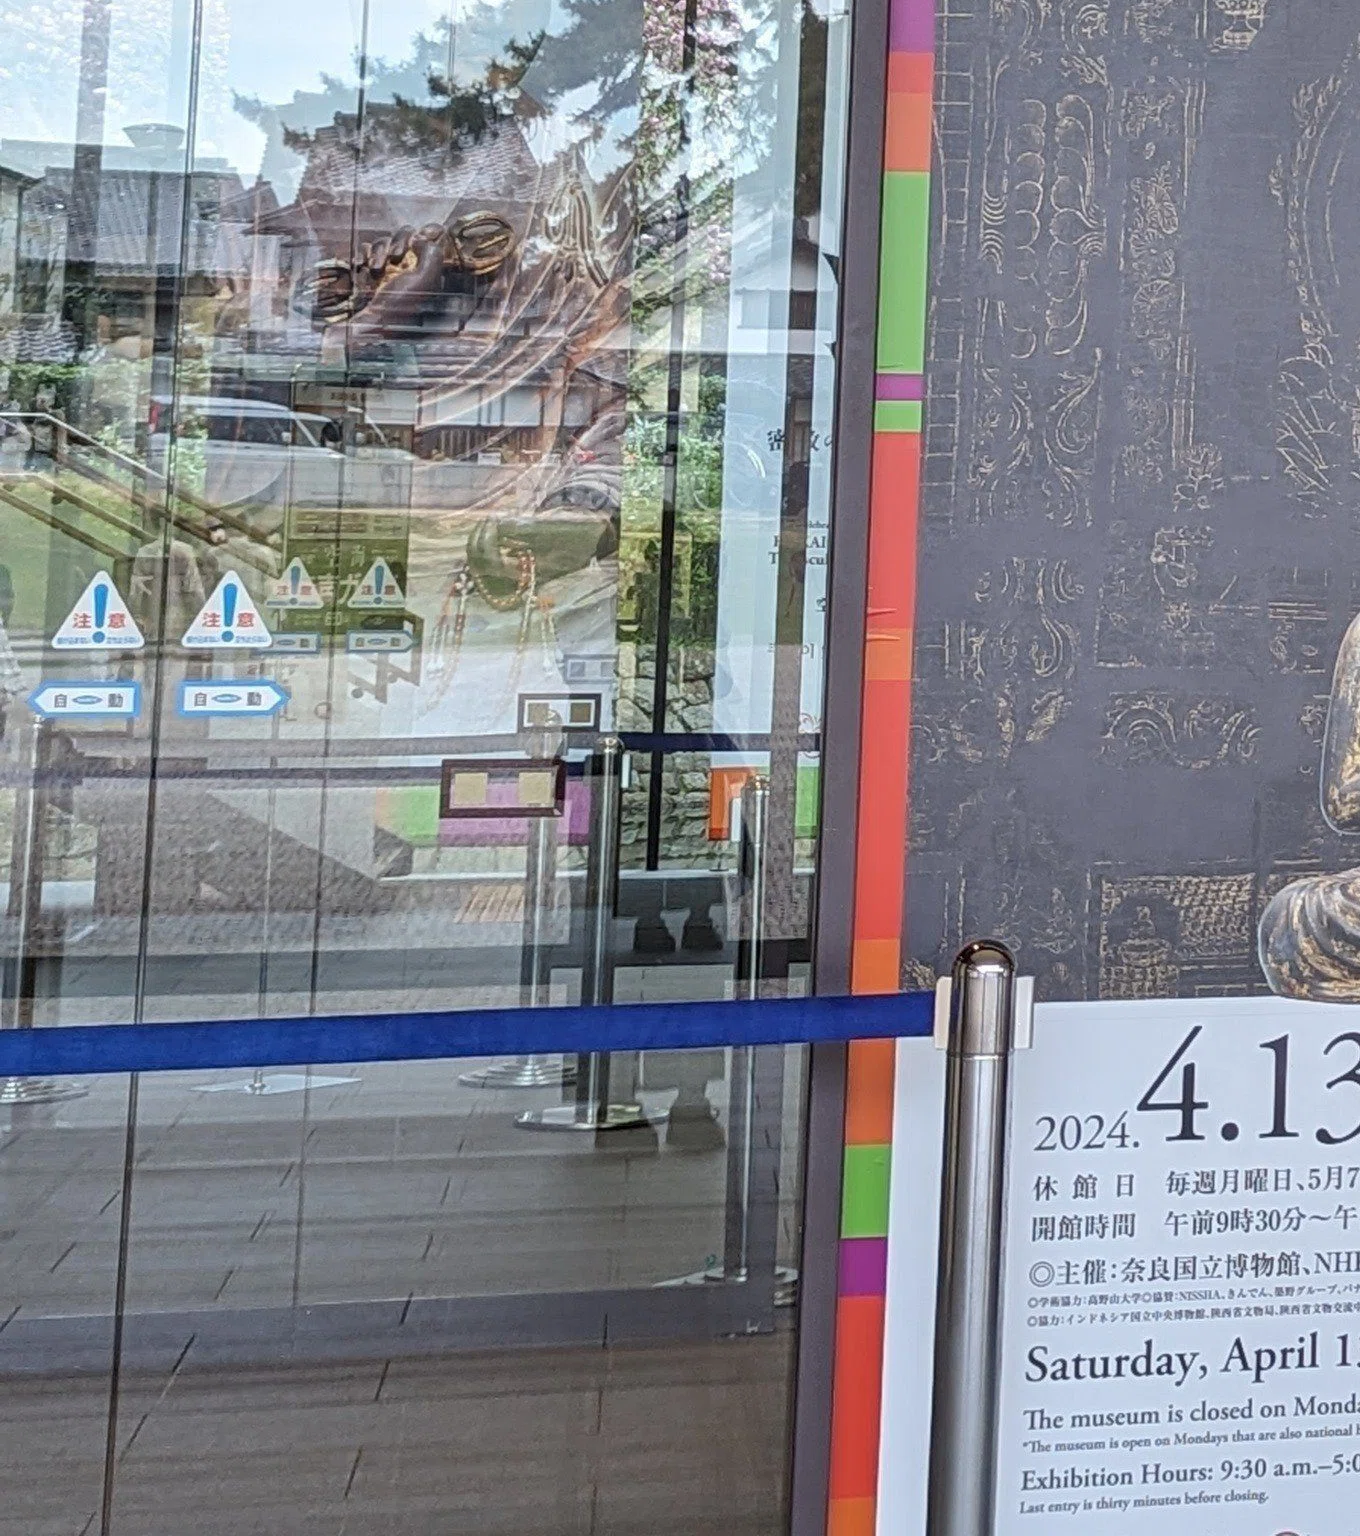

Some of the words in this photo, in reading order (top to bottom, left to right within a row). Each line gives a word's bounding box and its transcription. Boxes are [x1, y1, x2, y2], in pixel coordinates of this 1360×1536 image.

[1031, 1213, 1137, 1243] 開館時間
[1025, 1338, 1208, 1388] Saturday,
[1219, 1331, 1320, 1384] April
[1022, 1408, 1064, 1431] The
[1070, 1410, 1161, 1429] museum
[1167, 1403, 1184, 1423] is
[1189, 1397, 1254, 1422] closed
[1259, 1404, 1287, 1419] on
[1054, 1441, 1106, 1452] museum
[1108, 1437, 1120, 1449] is
[1121, 1438, 1152, 1452] open
[1154, 1437, 1171, 1447] on
[1173, 1430, 1229, 1447] Mondays
[1231, 1429, 1256, 1443] that
[1257, 1431, 1277, 1442] are
[1278, 1426, 1303, 1440] also
[1304, 1423, 1354, 1439] national
[1020, 1466, 1134, 1492] Exhibition
[1141, 1462, 1213, 1485] Hours:
[1220, 1458, 1267, 1481] 9:30
[1019, 1500, 1045, 1515] Last
[1047, 1502, 1081, 1516] entry
[1082, 1498, 1093, 1511] is
[1095, 1496, 1131, 1513] thirty
[1132, 1494, 1182, 1508] minutes
[1183, 1490, 1222, 1505] before
[1223, 1488, 1270, 1505] closing.
